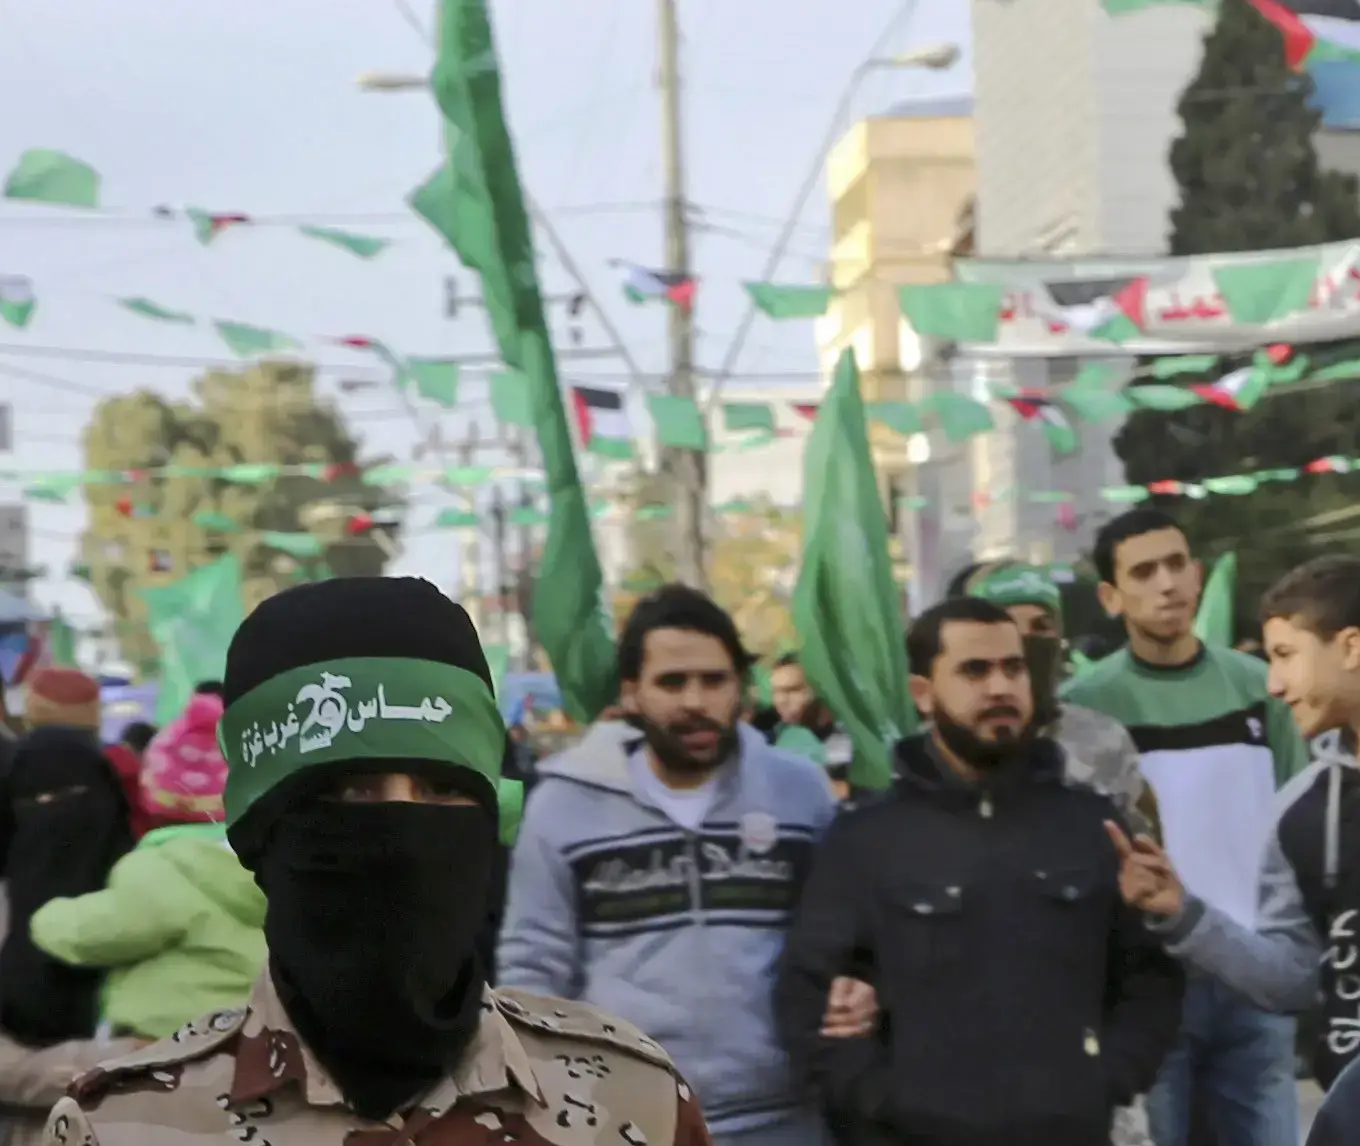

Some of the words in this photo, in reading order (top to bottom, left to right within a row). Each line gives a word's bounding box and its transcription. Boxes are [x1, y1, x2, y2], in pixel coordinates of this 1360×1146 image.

[263, 702, 300, 756] غرب
[347, 682, 453, 733] حماس
[242, 720, 264, 768] غزة
